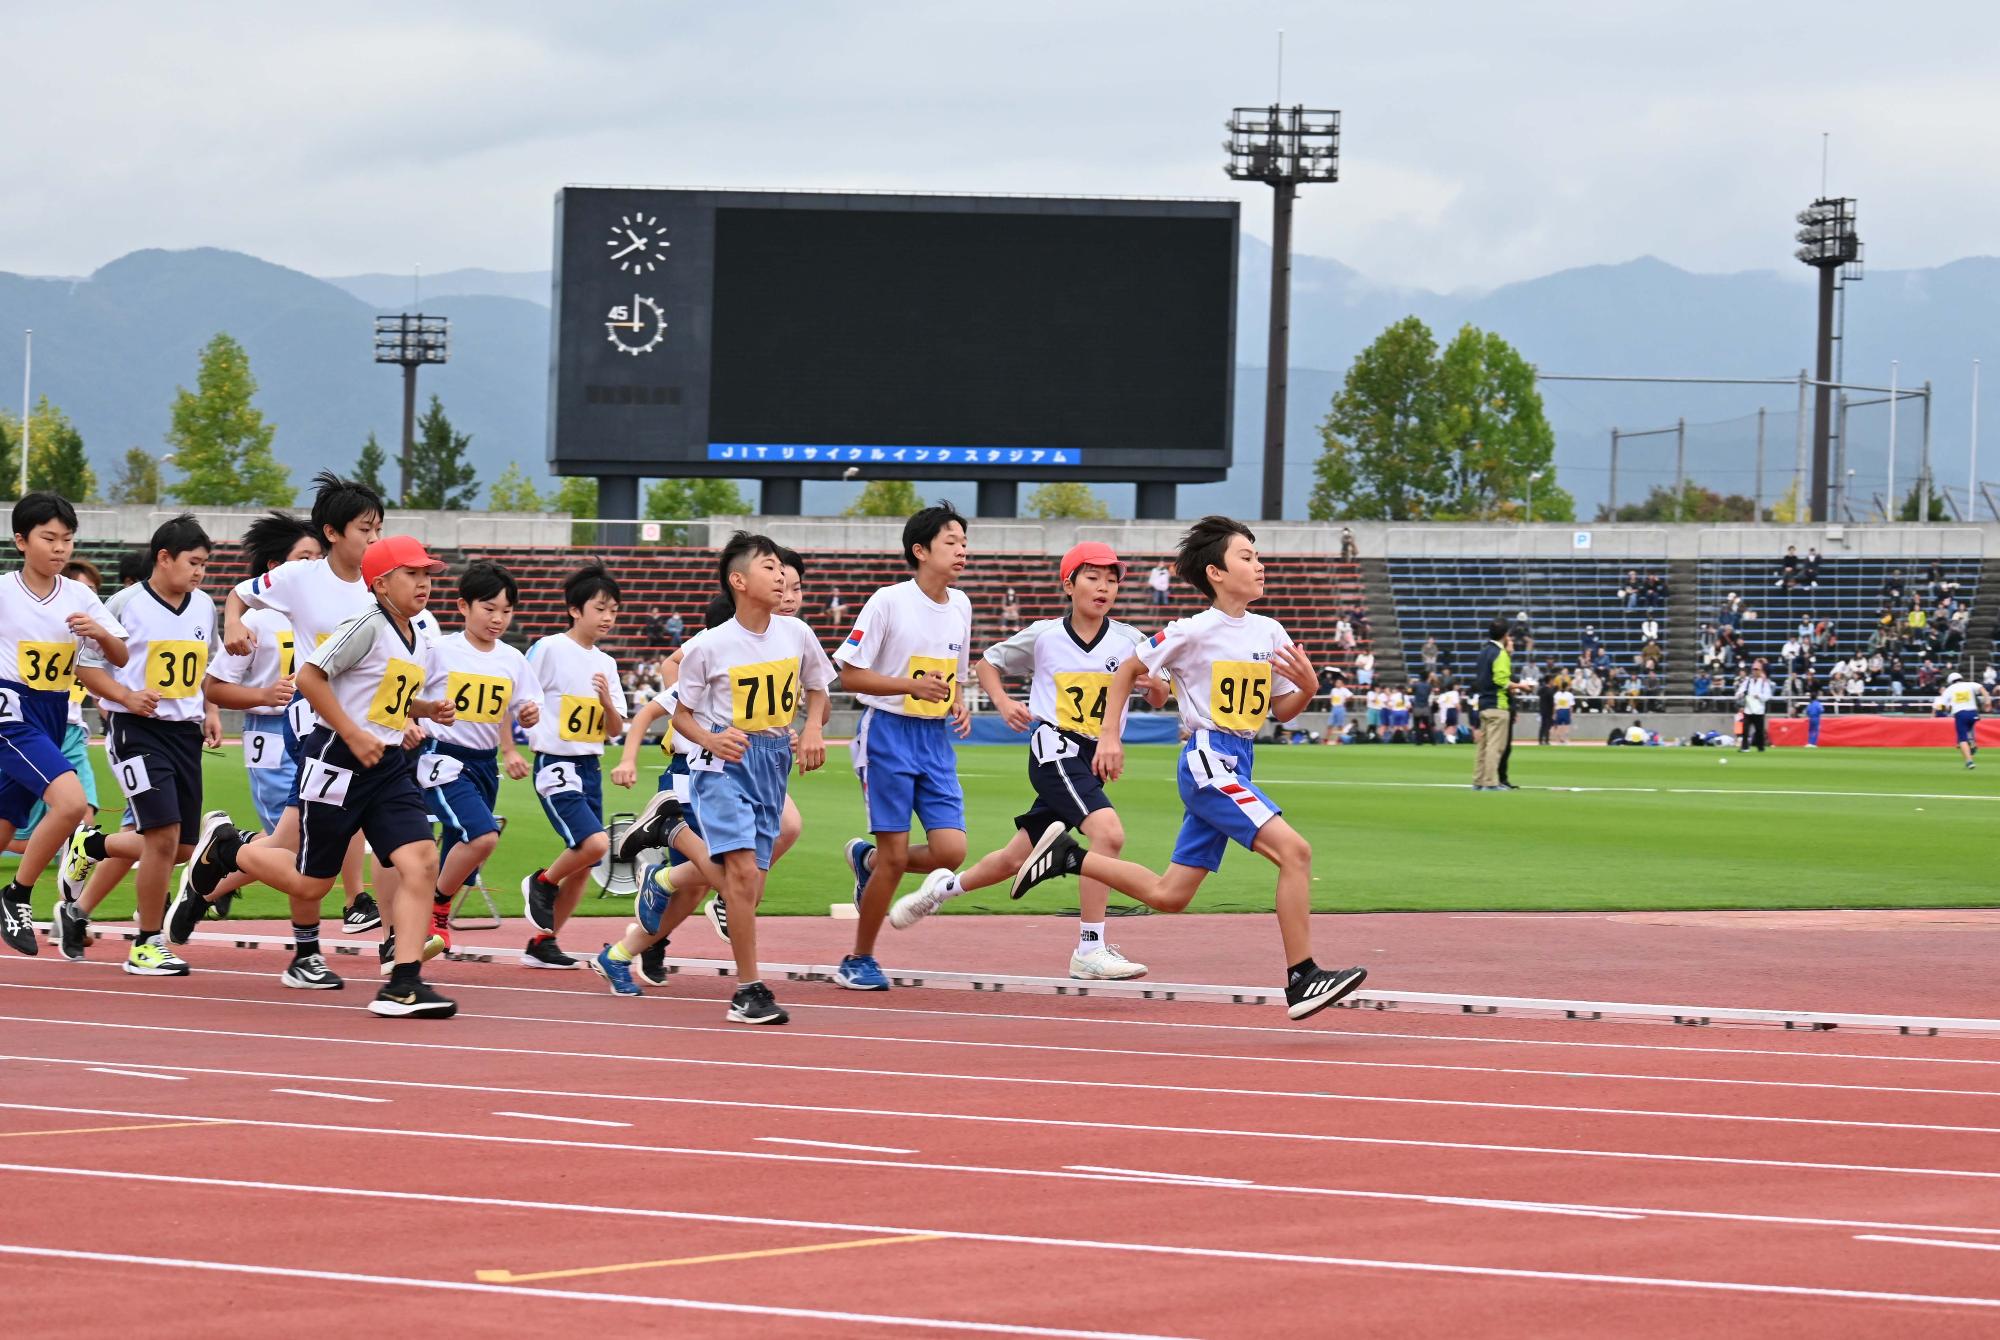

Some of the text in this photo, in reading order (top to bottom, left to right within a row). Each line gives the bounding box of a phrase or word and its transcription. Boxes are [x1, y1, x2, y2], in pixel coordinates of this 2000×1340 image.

[608, 306, 629, 321] 45
[720, 446, 1067, 463] JIT リサイクルインク スタジアム
[25, 649, 75, 682] 364
[159, 651, 198, 687] 30
[454, 681, 503, 716] 615
[737, 671, 795, 720] 716
[1218, 677, 1267, 716] 915
[567, 706, 605, 736] 614
[252, 735, 265, 764] 9
[301, 763, 339, 799] 17
[429, 759, 442, 782] 6
[551, 767, 567, 788] 3
